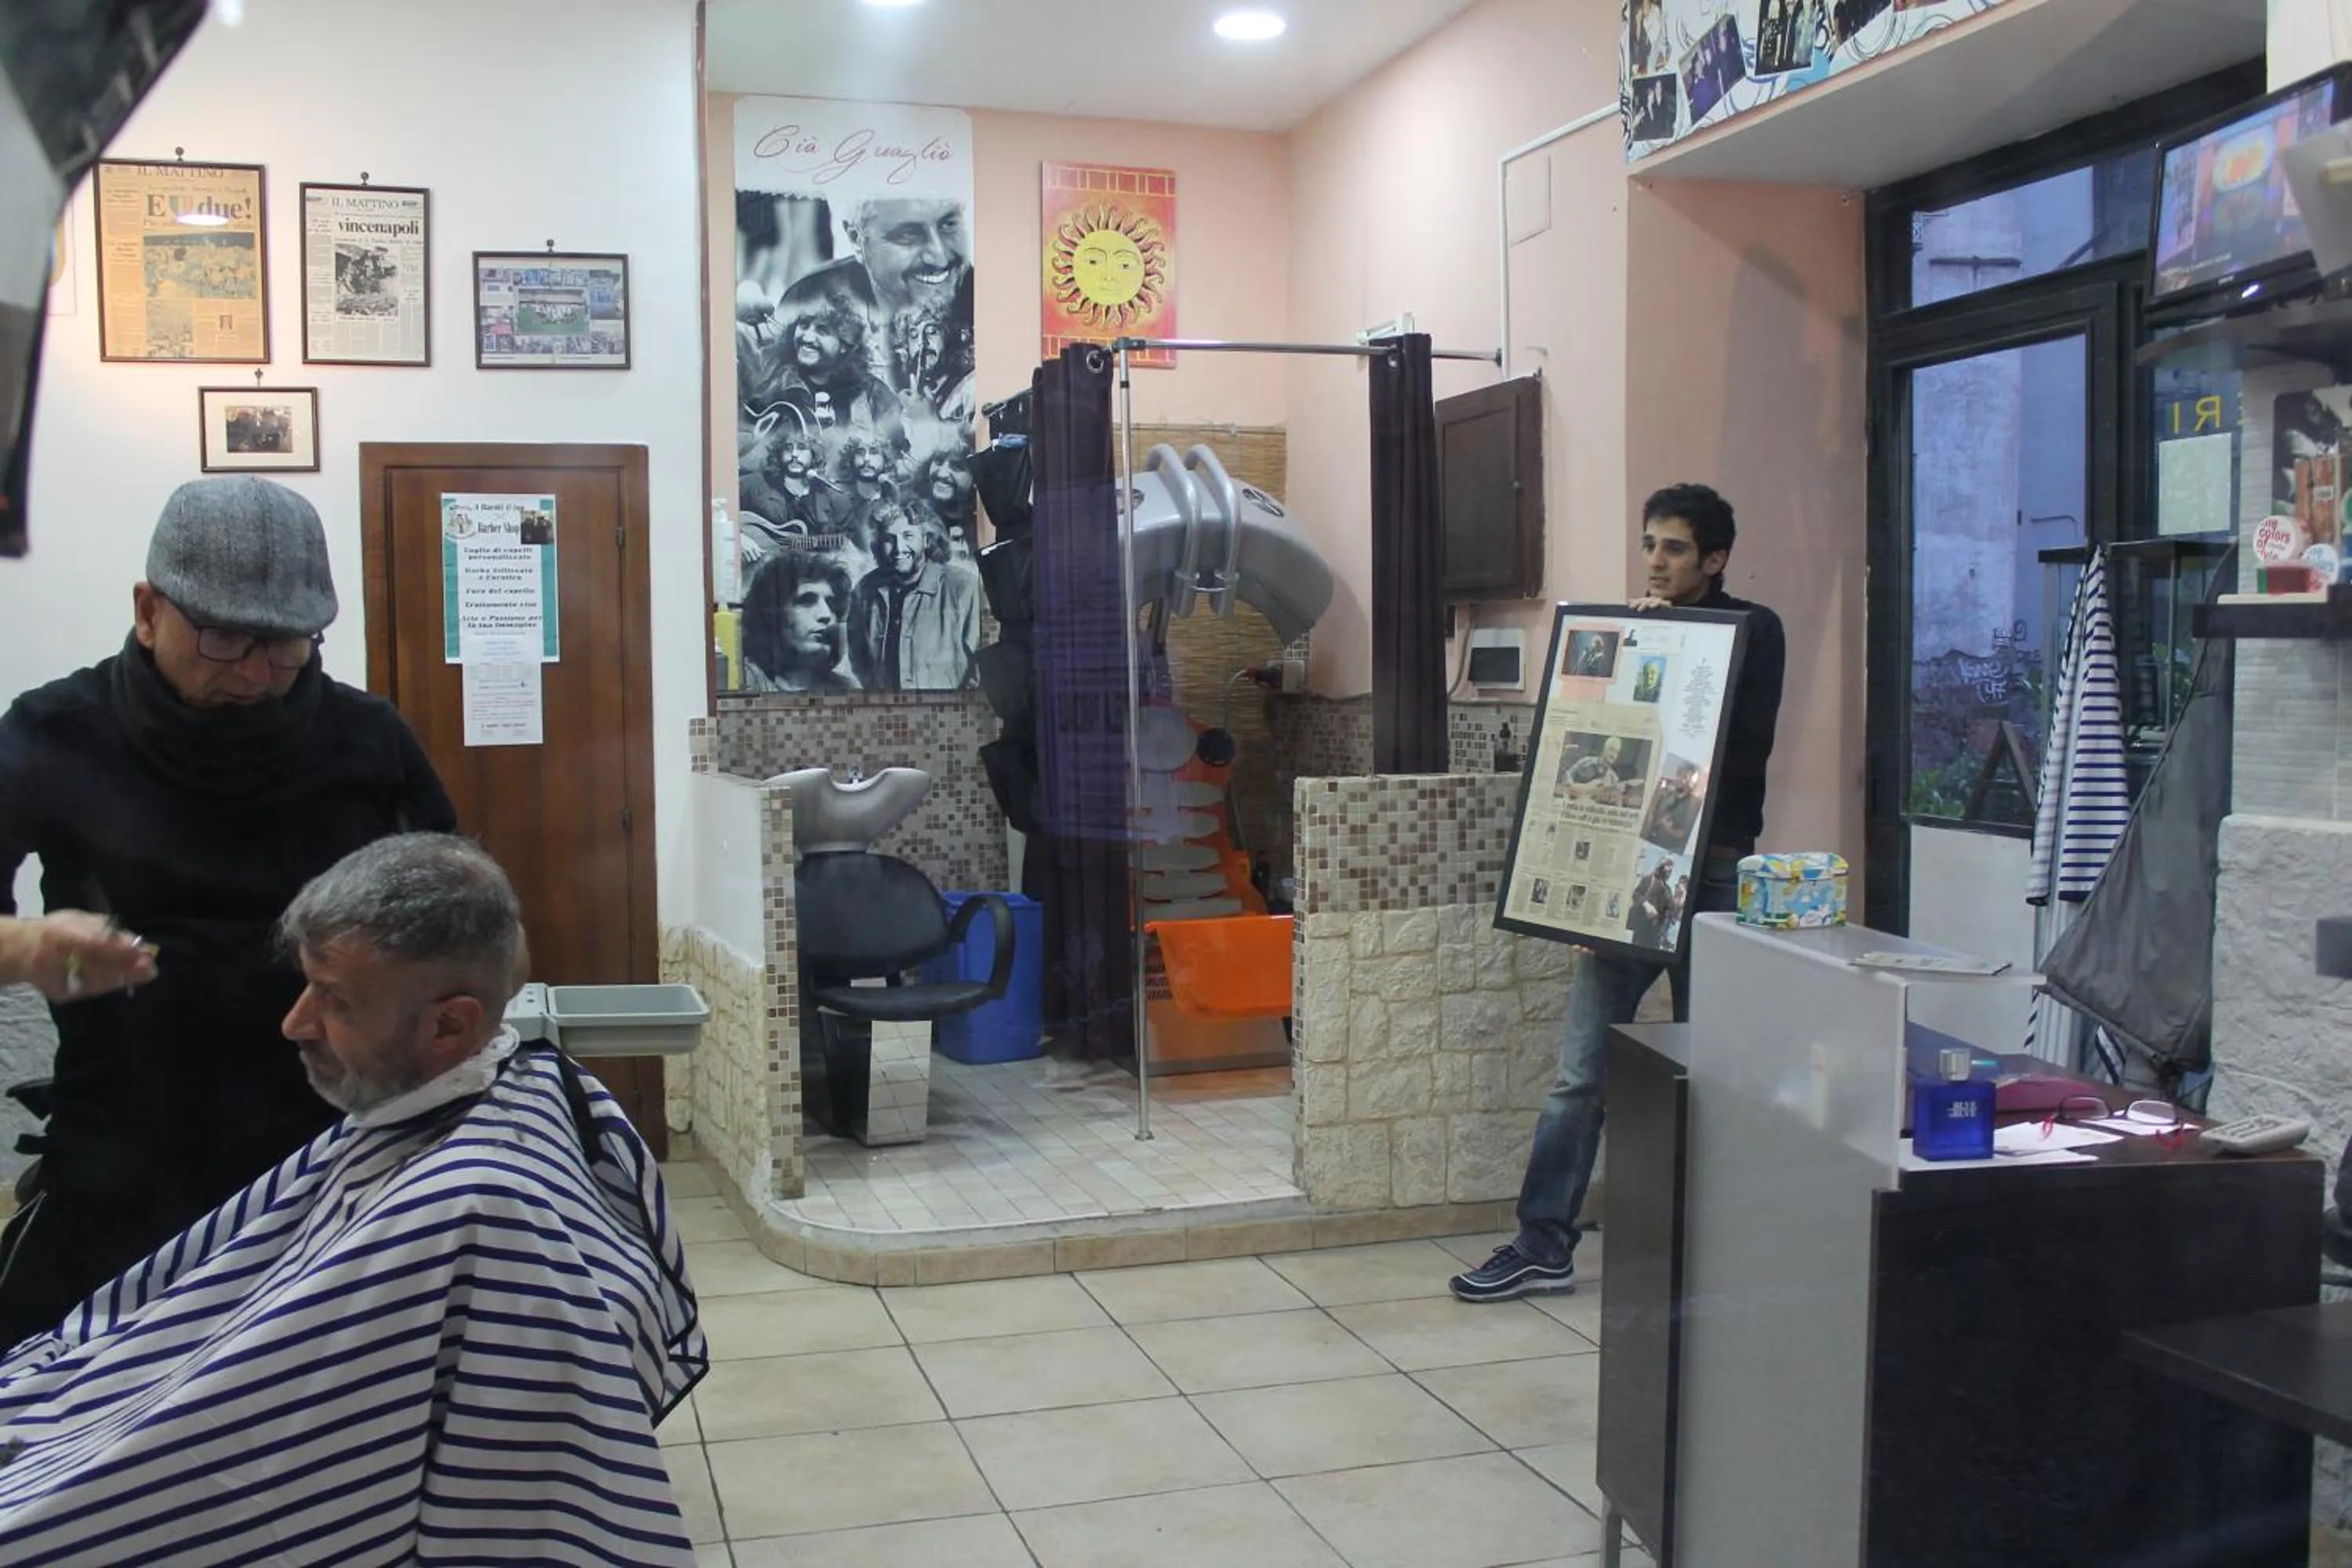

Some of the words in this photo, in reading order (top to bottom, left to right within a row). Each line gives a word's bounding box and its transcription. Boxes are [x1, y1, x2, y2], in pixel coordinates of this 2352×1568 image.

[137, 165, 152, 177] IL
[156, 166, 224, 178] MATTINO
[147, 194, 165, 217] E
[197, 196, 252, 220] due!
[332, 198, 343, 207] IL
[346, 198, 401, 210] MATTINO
[337, 216, 419, 238] vincenapoli
